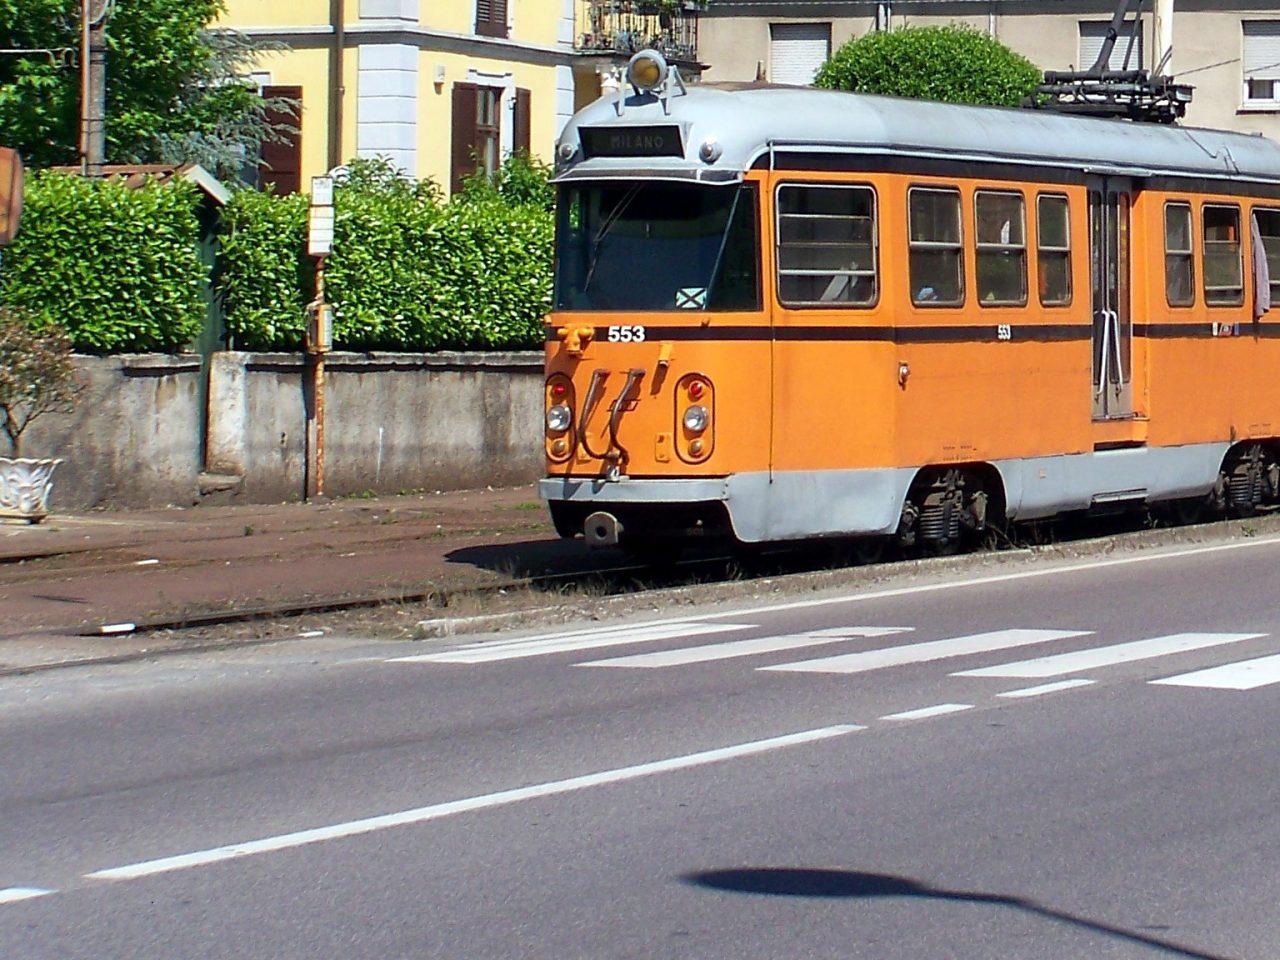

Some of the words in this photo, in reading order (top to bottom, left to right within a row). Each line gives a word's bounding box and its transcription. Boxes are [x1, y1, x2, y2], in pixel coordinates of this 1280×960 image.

[610, 136, 664, 148] MILANO
[608, 326, 645, 342] 553
[997, 324, 1011, 340] 553
